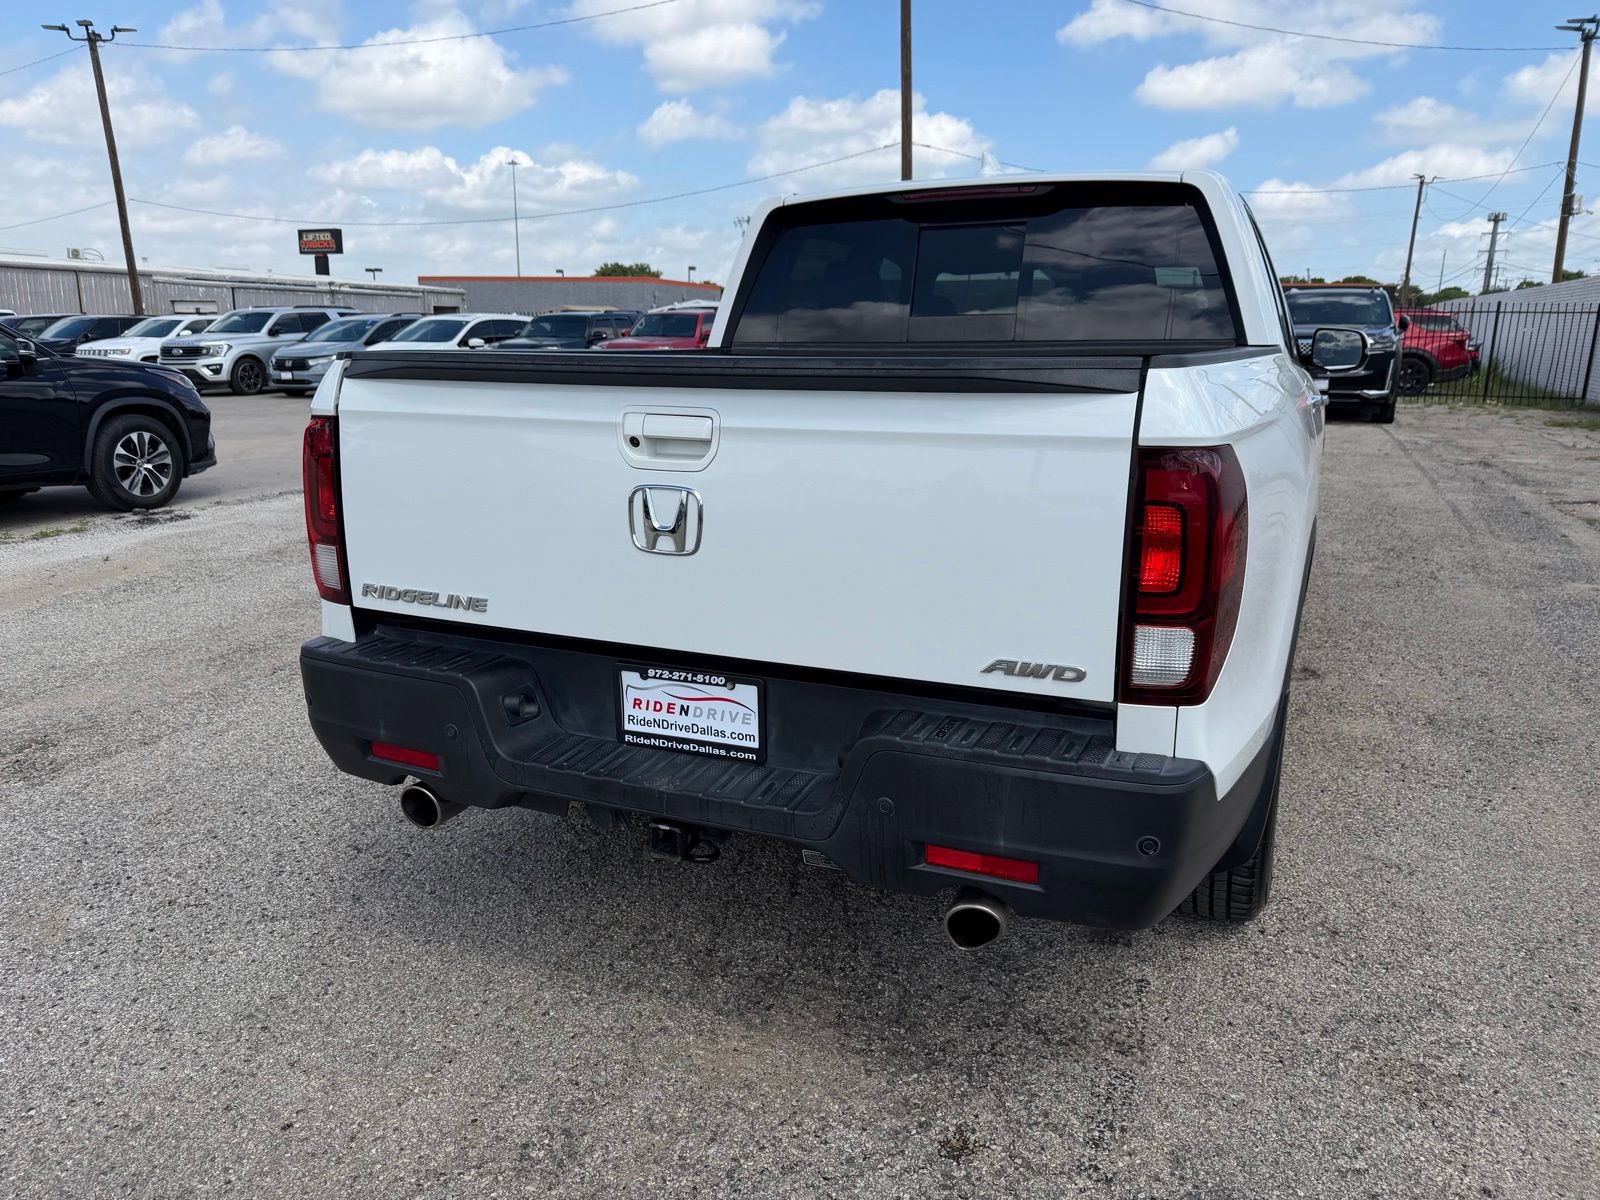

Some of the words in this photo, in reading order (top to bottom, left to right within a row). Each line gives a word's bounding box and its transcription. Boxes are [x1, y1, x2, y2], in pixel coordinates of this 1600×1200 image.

[361, 583, 489, 613] RIDGELINE
[647, 668, 726, 685] 972-271-5100
[980, 659, 1087, 682] AWD
[627, 714, 756, 743] RideNDriveDallas.com
[624, 734, 757, 761] RideNDriveDallas.com
